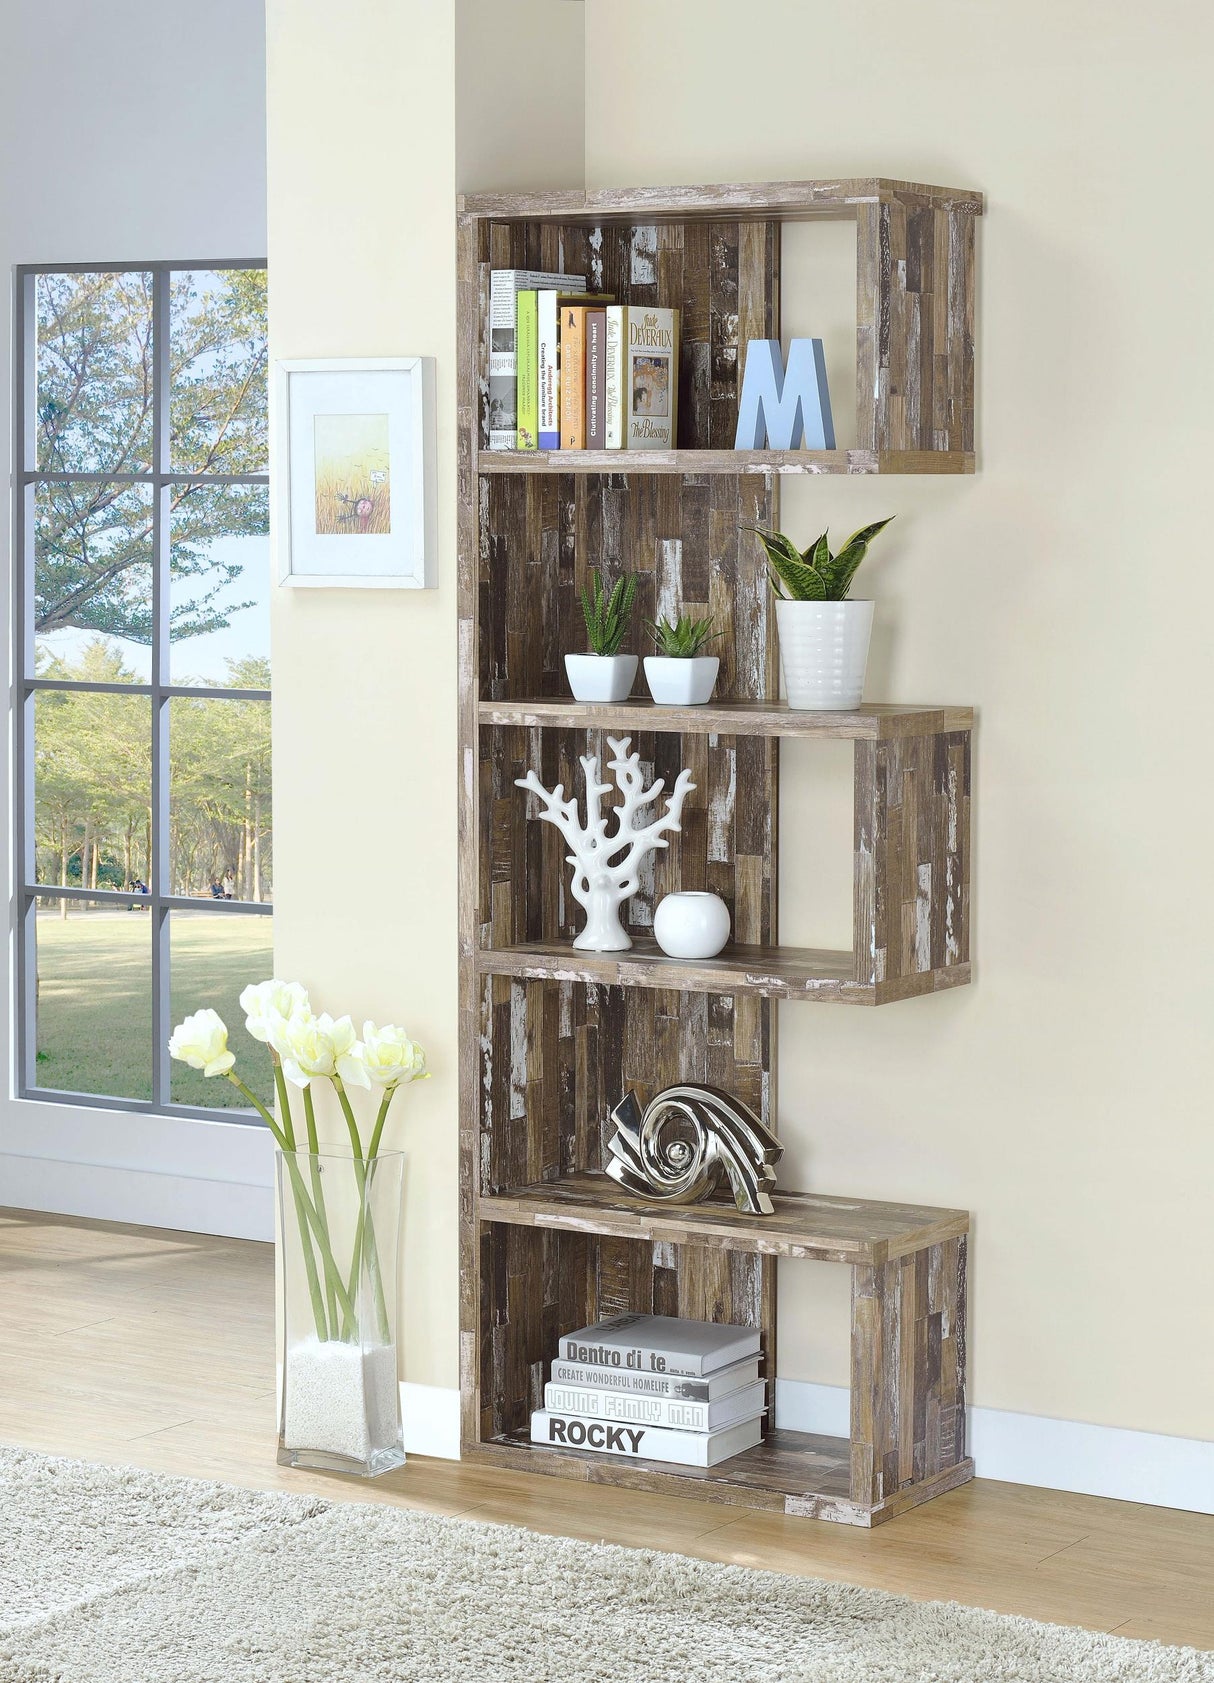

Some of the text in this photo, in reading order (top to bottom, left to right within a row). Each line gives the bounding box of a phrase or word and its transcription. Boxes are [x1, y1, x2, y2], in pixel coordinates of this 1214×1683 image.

[591, 345, 597, 353] in
[630, 323, 672, 348] DEVERAUX
[607, 340, 618, 381] DEVERAUX
[641, 418, 669, 443] Blessing
[566, 1341, 666, 1372] Dentro di te
[557, 1367, 669, 1393] CREATE WONDERFUL HOMELIFE
[604, 1396, 661, 1422] FAMILY
[668, 1404, 703, 1427] MAN
[549, 1417, 645, 1453] ROCKY
